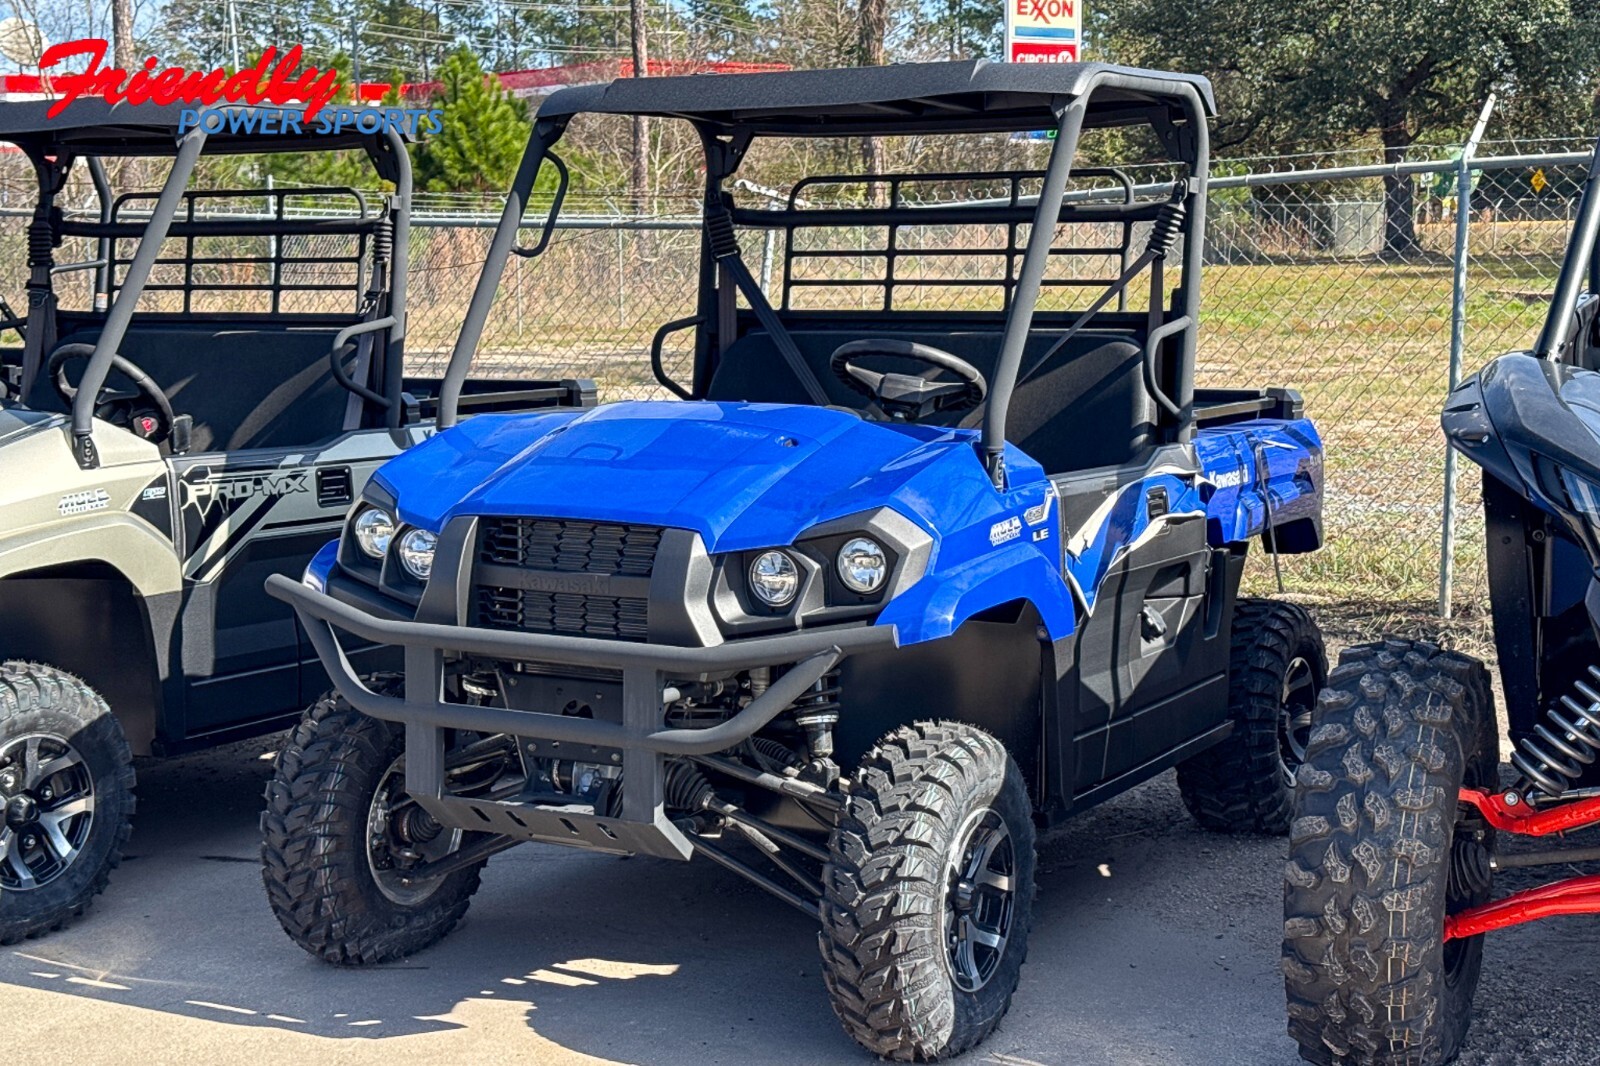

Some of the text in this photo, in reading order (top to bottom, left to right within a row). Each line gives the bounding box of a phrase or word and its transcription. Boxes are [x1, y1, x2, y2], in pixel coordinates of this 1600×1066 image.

[1016, 0, 1074, 24] EXXON
[186, 475, 309, 502] PRO-MX
[1032, 528, 1049, 542] LE
[519, 571, 612, 596] Kawasaki
